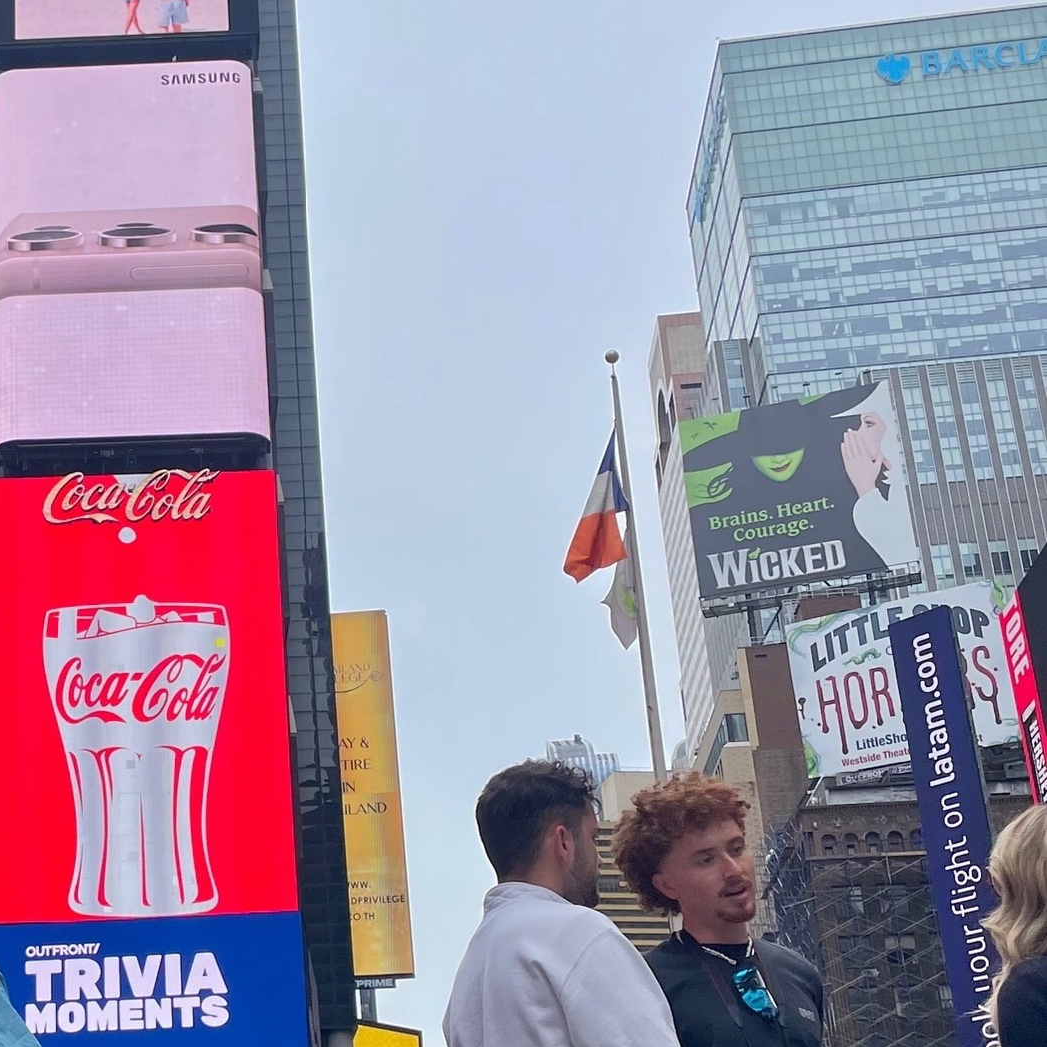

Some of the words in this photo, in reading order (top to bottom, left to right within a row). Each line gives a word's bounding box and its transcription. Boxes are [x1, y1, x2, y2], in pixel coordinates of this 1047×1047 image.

[160, 71, 241, 86] SAMSUNG
[708, 510, 773, 531] Brains.
[776, 497, 834, 518] Heart.
[733, 519, 814, 542] Courage.
[55, 653, 227, 725] Coca-Cola
[912, 632, 956, 788] latam.com
[360, 737, 370, 749] &
[841, 754, 882, 767] Westside
[943, 792, 963, 829] on
[946, 838, 982, 917] flight
[25, 952, 229, 1002] TRIVIA
[25, 995, 231, 1034] MOMENTS
